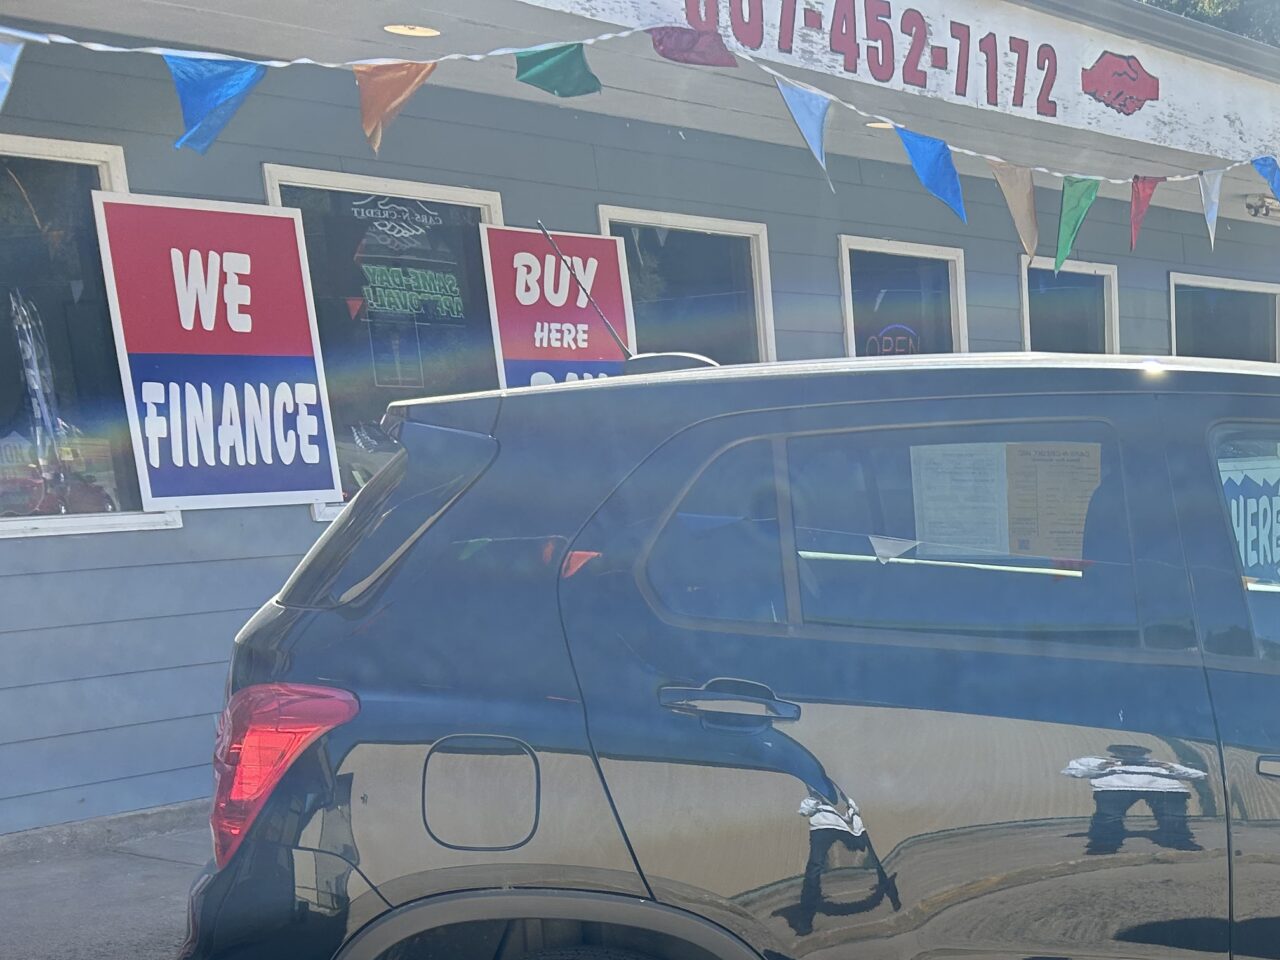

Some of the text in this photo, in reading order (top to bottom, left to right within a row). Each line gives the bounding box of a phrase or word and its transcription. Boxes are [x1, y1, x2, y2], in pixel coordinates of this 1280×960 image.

[170, 247, 253, 333] WE
[513, 251, 599, 309] BUY
[534, 321, 589, 350] HERE
[141, 381, 320, 468] FINANCE
